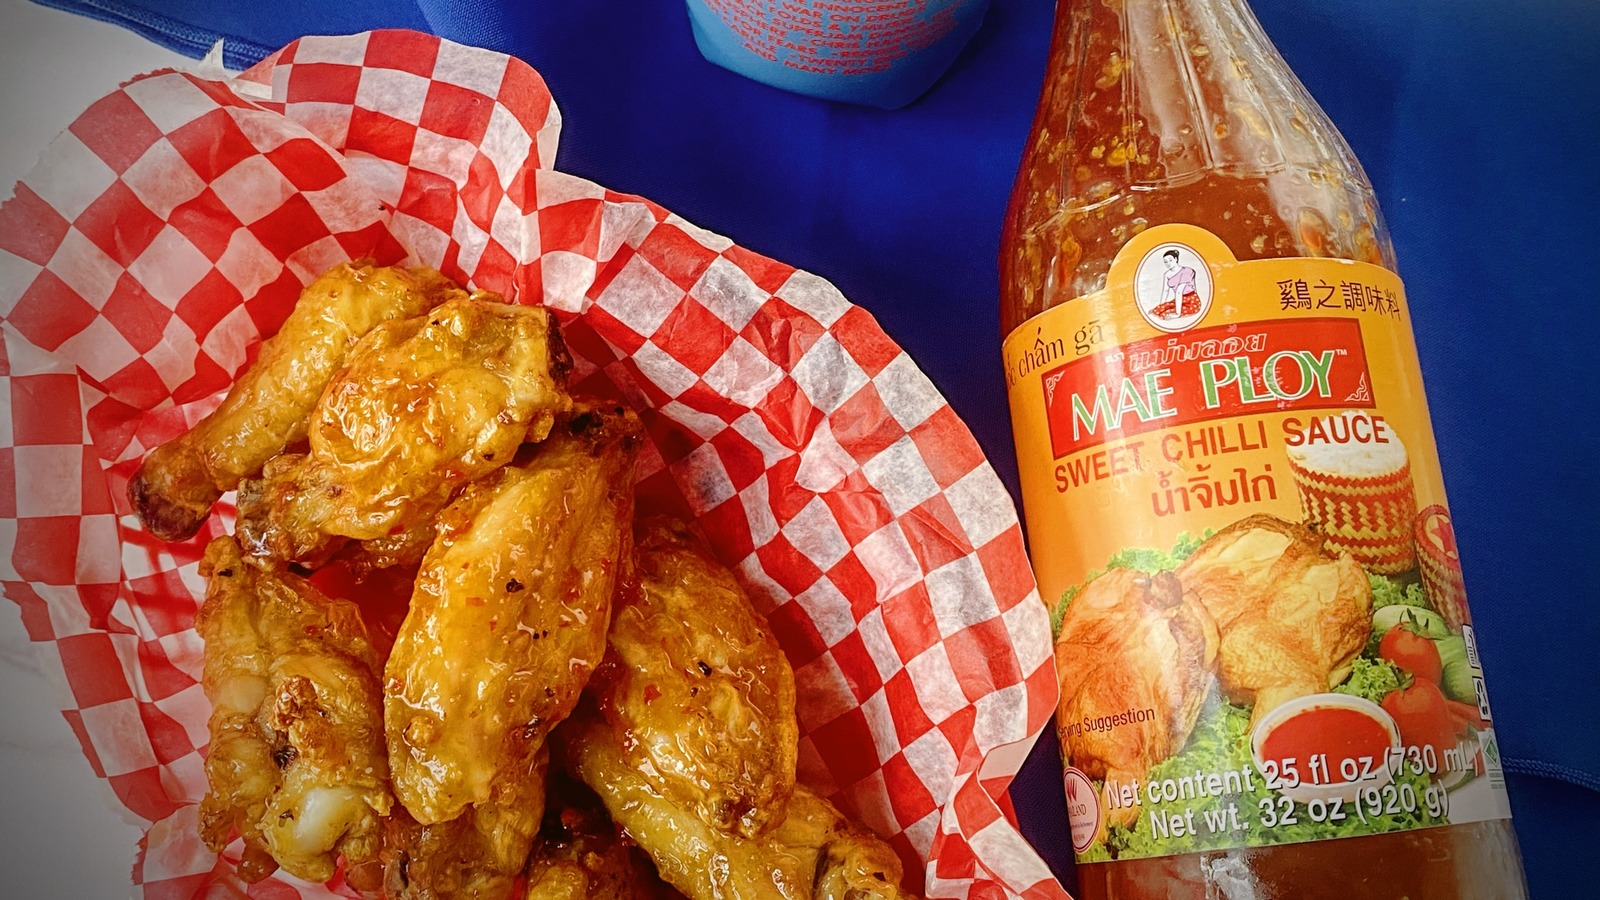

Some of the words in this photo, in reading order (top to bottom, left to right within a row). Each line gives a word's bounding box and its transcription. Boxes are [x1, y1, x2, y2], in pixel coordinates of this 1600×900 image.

[782, 1, 823, 18] WAR
[829, 14, 860, 23] ON
[784, 60, 838, 75] MANY
[1071, 370, 1177, 442] MAE
[1201, 350, 1337, 409] PLOY
[1055, 441, 1145, 493] SWEET
[1161, 420, 1269, 464] CHILLI
[1282, 416, 1390, 447] SAUCE
[1083, 708, 1156, 733] Suggestion
[1107, 777, 1141, 810] Net
[1146, 761, 1254, 804] content
[1264, 757, 1300, 788] 25
[1309, 753, 1329, 785] fl
[1341, 756, 1373, 781] oz
[1384, 745, 1436, 785] (730
[1150, 810, 1195, 841] Net
[1203, 803, 1251, 834] wt.
[1260, 797, 1300, 828] 32
[1308, 794, 1347, 822] oz
[1355, 783, 1415, 825] (920
[1424, 780, 1450, 819] g)
